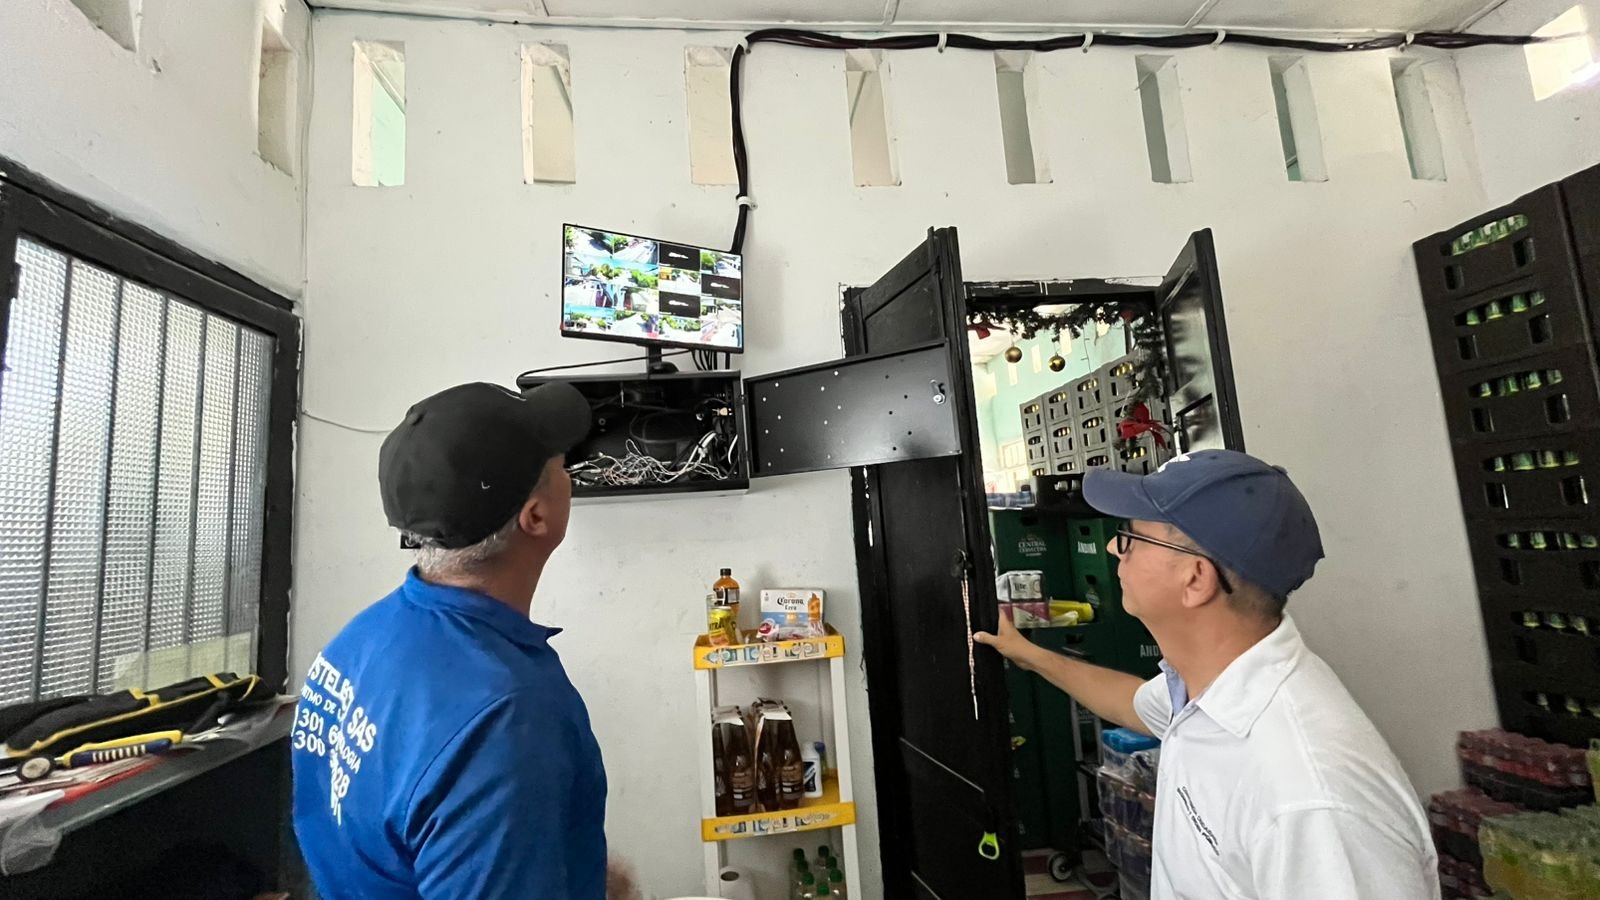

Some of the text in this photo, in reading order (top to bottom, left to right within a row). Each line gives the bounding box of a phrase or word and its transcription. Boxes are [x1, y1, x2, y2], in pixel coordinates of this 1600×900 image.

[776, 596, 804, 606] Corona
[1139, 644, 1159, 658] AND
[298, 708, 324, 736] 301
[347, 706, 377, 752] SAS
[294, 730, 325, 757] 300
